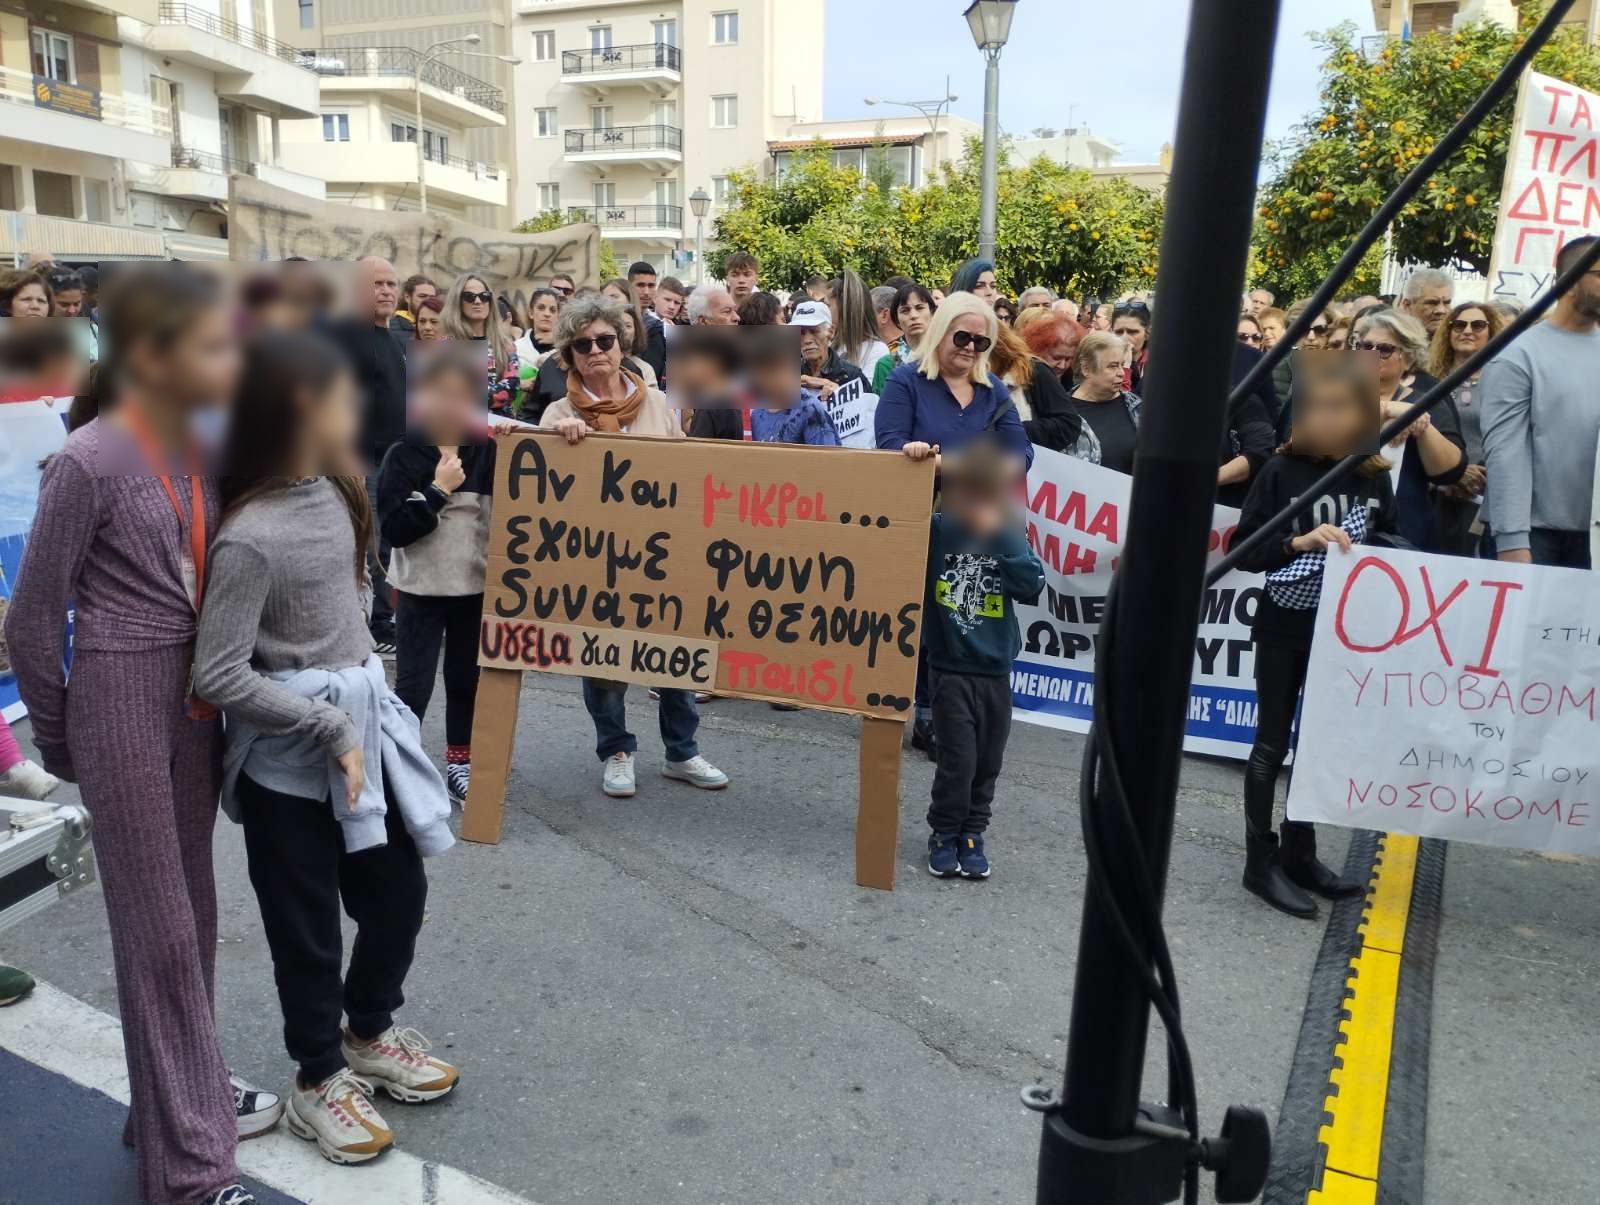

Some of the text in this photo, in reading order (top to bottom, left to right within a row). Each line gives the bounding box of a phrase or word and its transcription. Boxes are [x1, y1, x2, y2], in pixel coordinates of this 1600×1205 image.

[1544, 85, 1593, 130] ΤΑ
[508, 439, 575, 504] Αν
[1026, 480, 1118, 544] ΛΛΑ
[507, 515, 671, 589] εχουμε
[1335, 556, 1523, 677] ΟΧΙ
[580, 631, 620, 667] για
[1024, 620, 1098, 660] ΩΡ
[1197, 638, 1258, 677] ΥΓ
[1187, 695, 1212, 723] ΗΣ
[1346, 667, 1596, 721] ΥΠΟΒΑΘΜ
[1399, 748, 1589, 784] ΔΗΜΟΣΙΟΥ
[1346, 778, 1590, 826] ΝΟΣΟΚΟΜΕ
